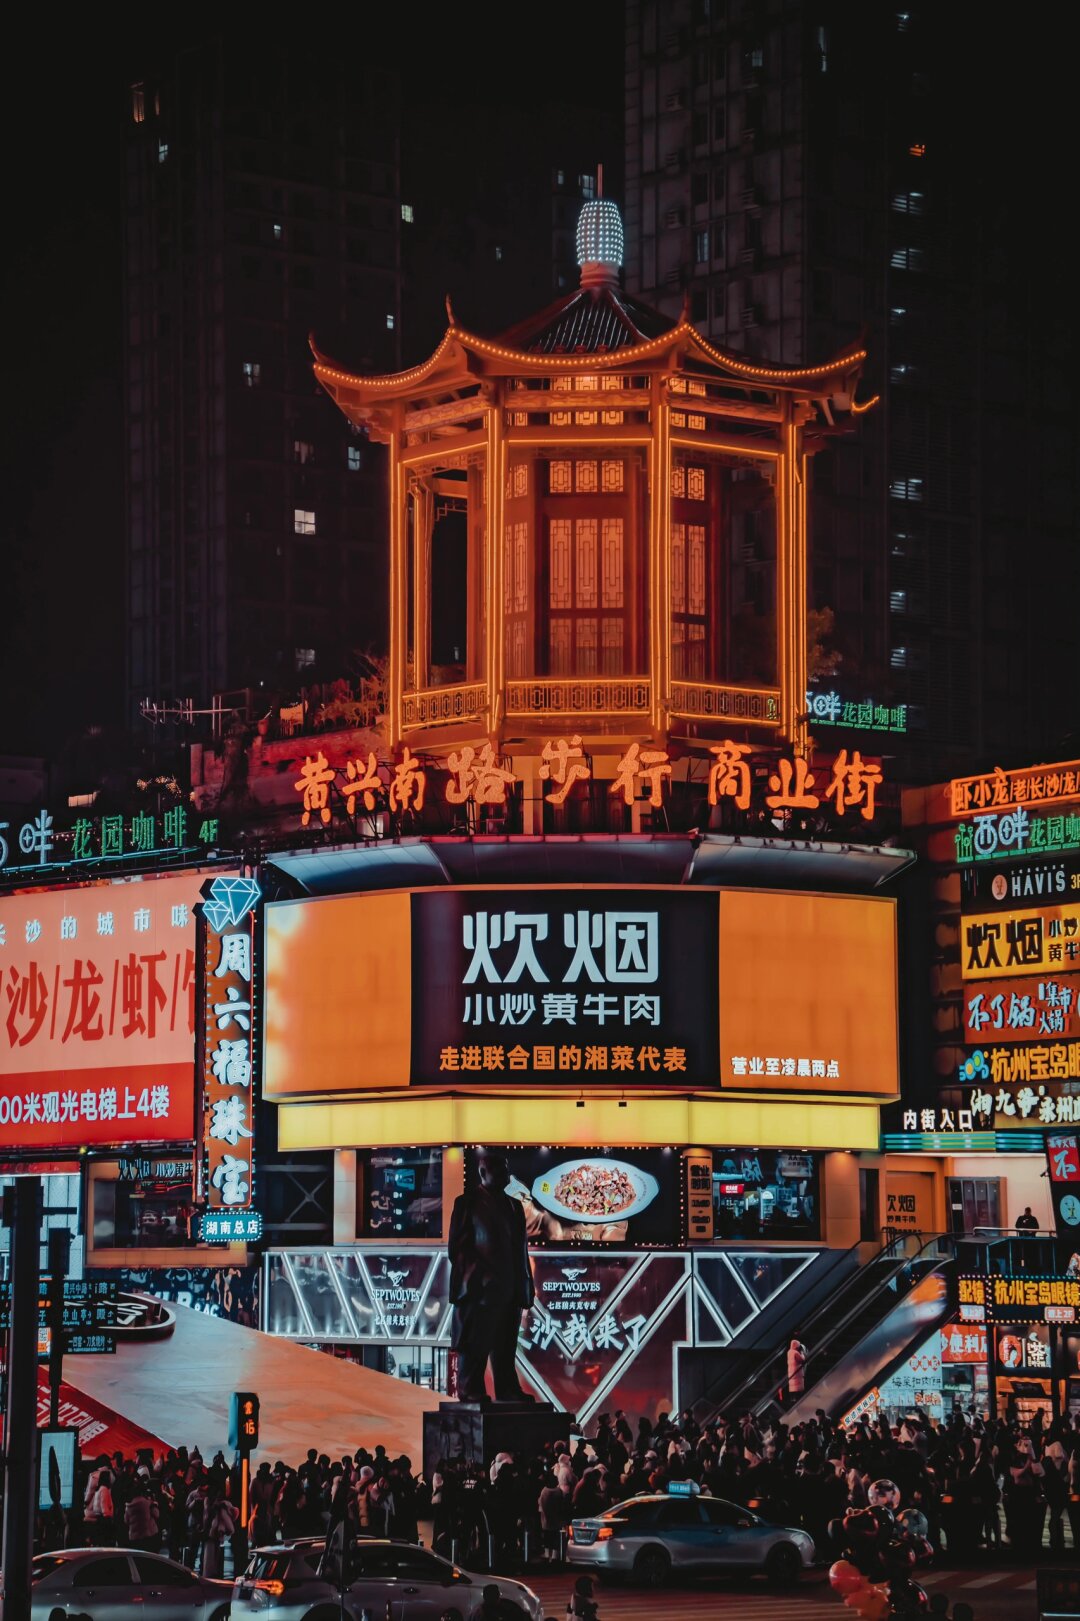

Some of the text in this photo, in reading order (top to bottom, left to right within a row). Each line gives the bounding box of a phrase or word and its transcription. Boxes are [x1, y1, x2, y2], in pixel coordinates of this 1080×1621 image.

[294, 735, 883, 826] 黄兴南路步行商业街
[1011, 870, 1066, 897] HAVIS
[1048, 918, 1080, 938] 小炒
[462, 910, 658, 983] 炊烟
[966, 917, 1043, 970] 炊烟
[462, 993, 661, 1025] 小炒黄牛肉
[210, 933, 253, 1205] 周六福珠宝
[440, 1044, 687, 1072] 走进联合国的湘菜代表
[731, 1056, 840, 1078] 营业至凌晨两点
[903, 1109, 973, 1130] 内街入口
[206, 1219, 258, 1235] 湖南总店
[371, 1288, 421, 1302] SEPTWOLVES
[542, 1281, 601, 1292] SEPTWOLVES
[994, 1279, 1080, 1307] 杭州宝岛眼镜
